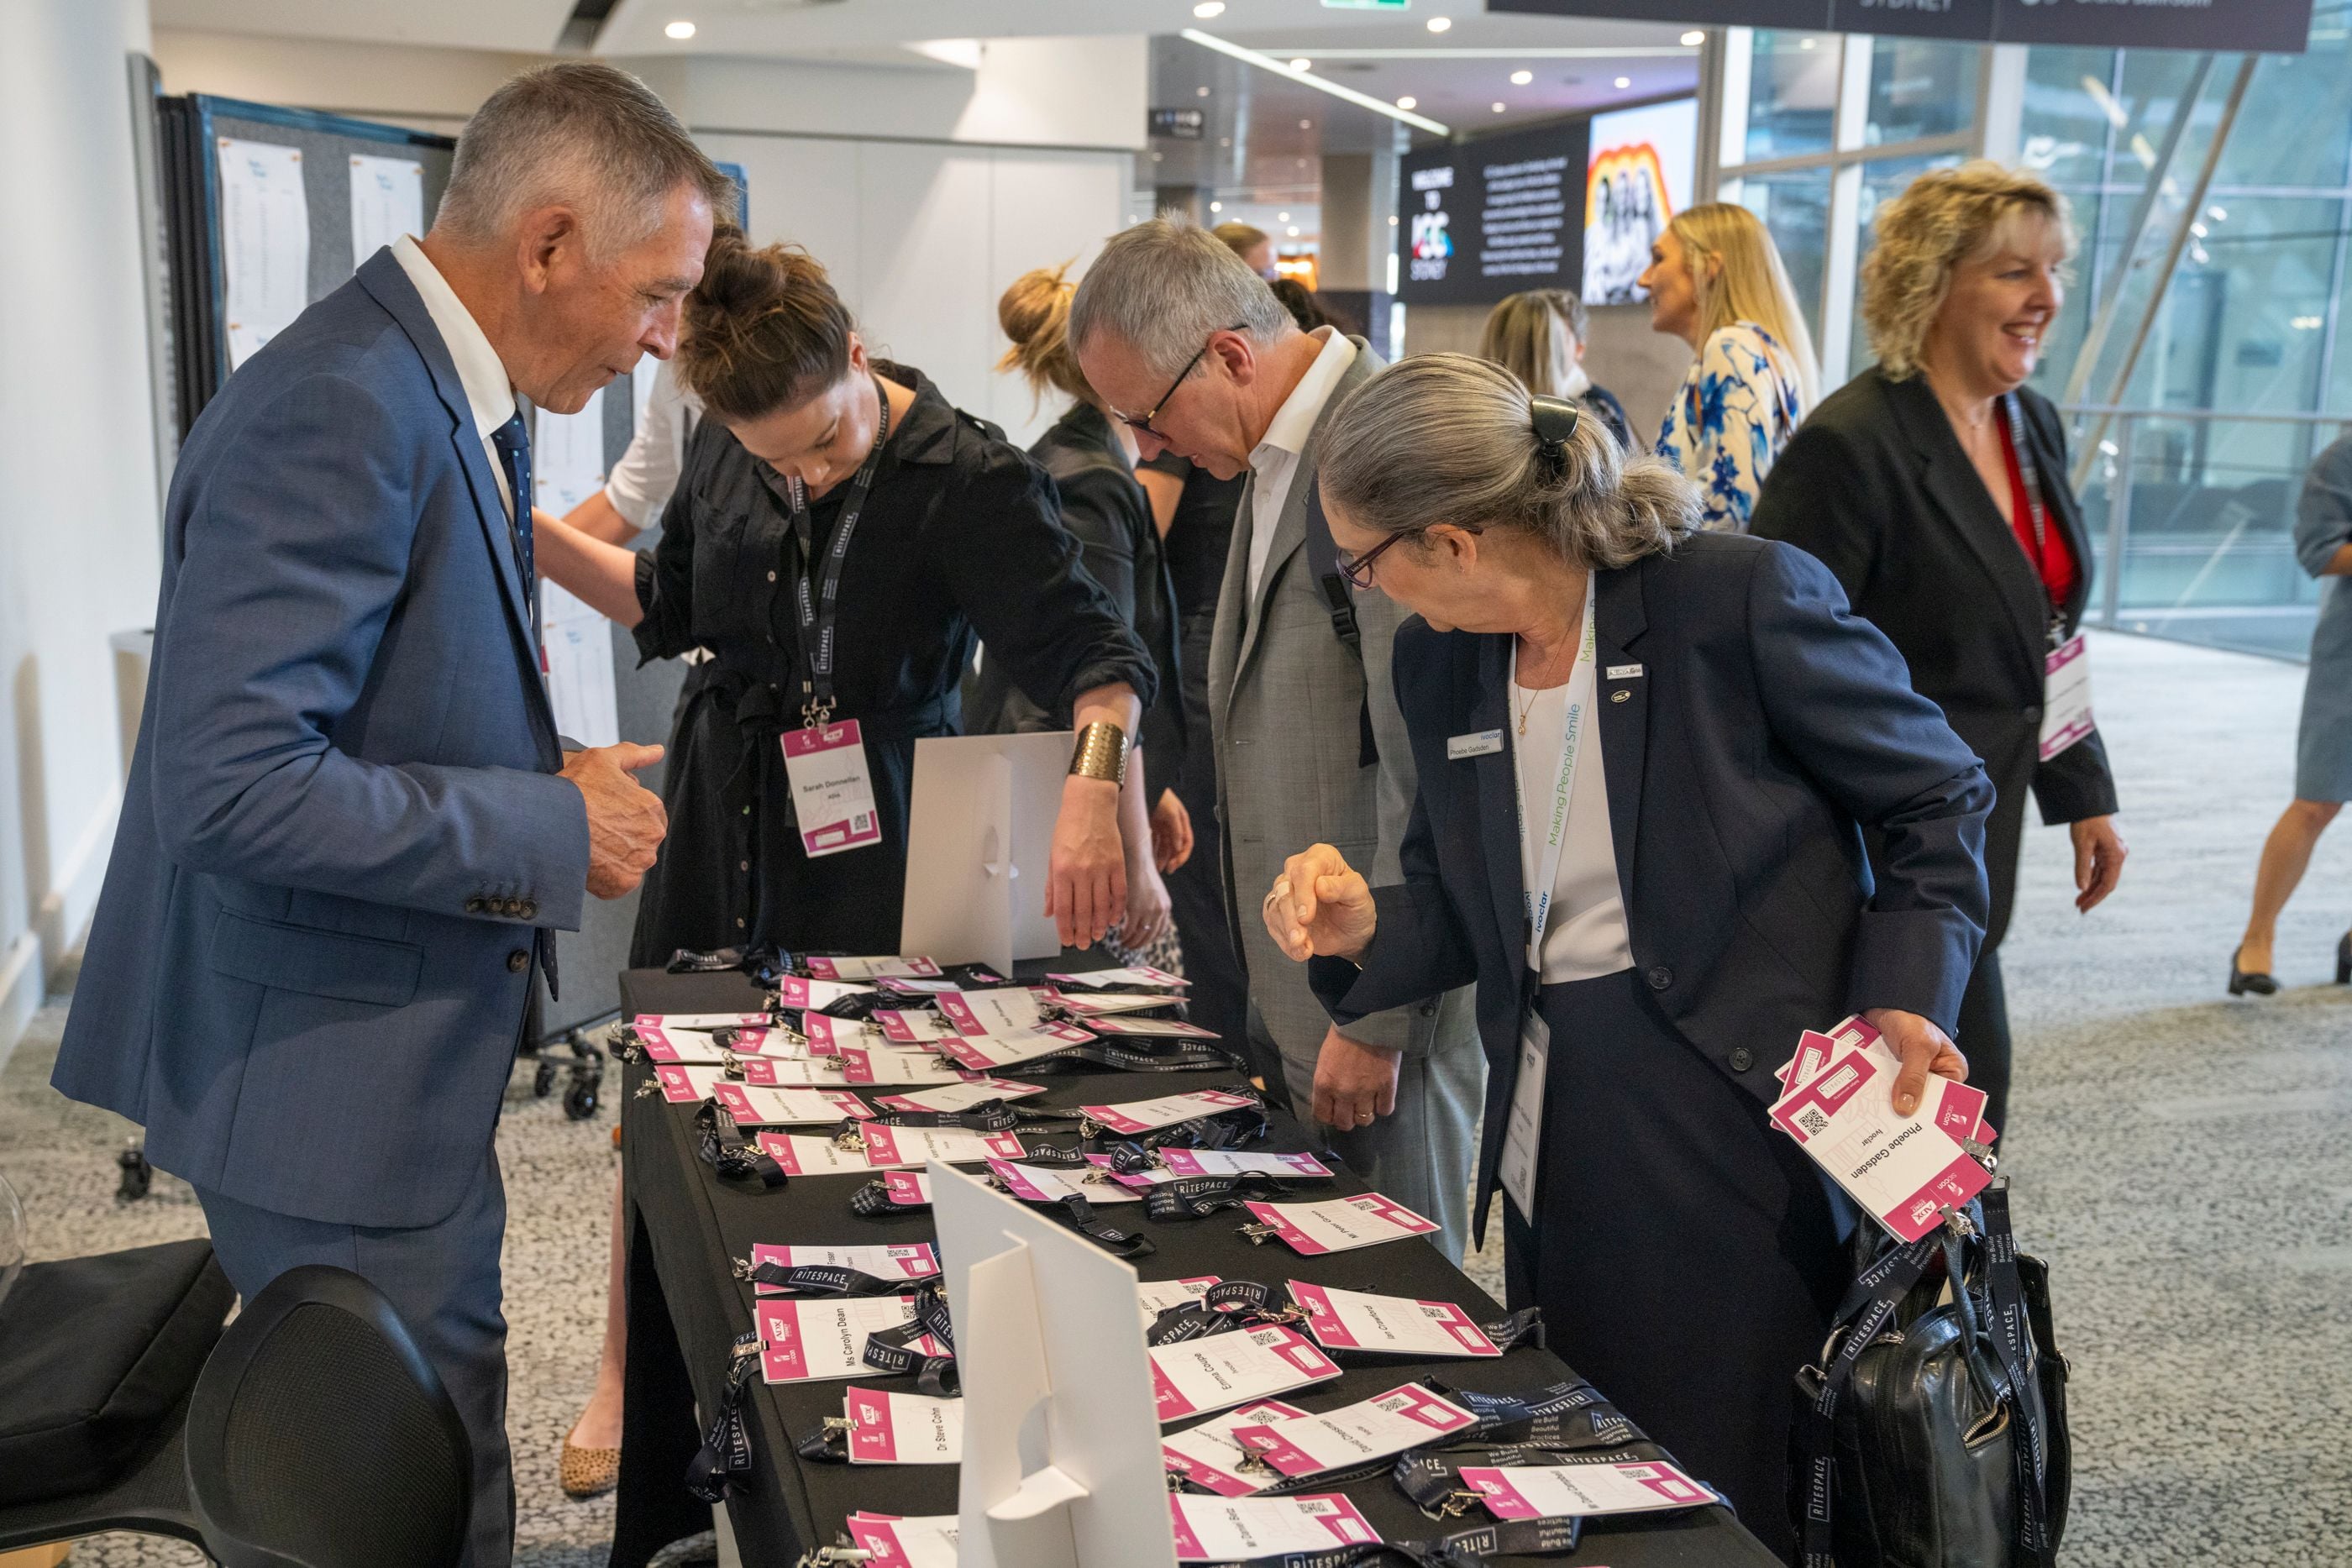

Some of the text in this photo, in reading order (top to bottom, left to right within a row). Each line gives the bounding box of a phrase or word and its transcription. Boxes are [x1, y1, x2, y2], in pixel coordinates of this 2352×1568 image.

[1480, 732, 1500, 740] ivoclar
[1450, 747, 1467, 756] Phoebe
[1549, 704, 1581, 847] Making People Smile
[1535, 891, 1548, 933] ivoclar
[1851, 1122, 1923, 1179] Phoebe Gadsden
[1861, 1129, 1883, 1147] Ivoclar
[1179, 1182, 1229, 1193] RITESPACE
[1914, 1204, 1933, 1220] ADX
[1996, 1234, 2006, 1263] Beautiful
[2003, 1232, 2013, 1262] Practices
[795, 1271, 847, 1284] RITESPACE
[1211, 1286, 1262, 1302] RITESPACE
[774, 1321, 783, 1338] ADX
[1363, 1304, 1395, 1340] Ian Crawford
[1847, 1299, 1887, 1354] RITESPACE
[837, 1308, 856, 1366] Ms Carolyn Dean
[1194, 1352, 1232, 1391] Emma Coupe
[730, 1402, 746, 1466] RITESPACE
[932, 1407, 948, 1451] Dr Steve Cohn
[1542, 1415, 1559, 1424] Build
[1564, 1452, 1630, 1465] RITESPACE
[1813, 1458, 1825, 1516] RITESPACE
